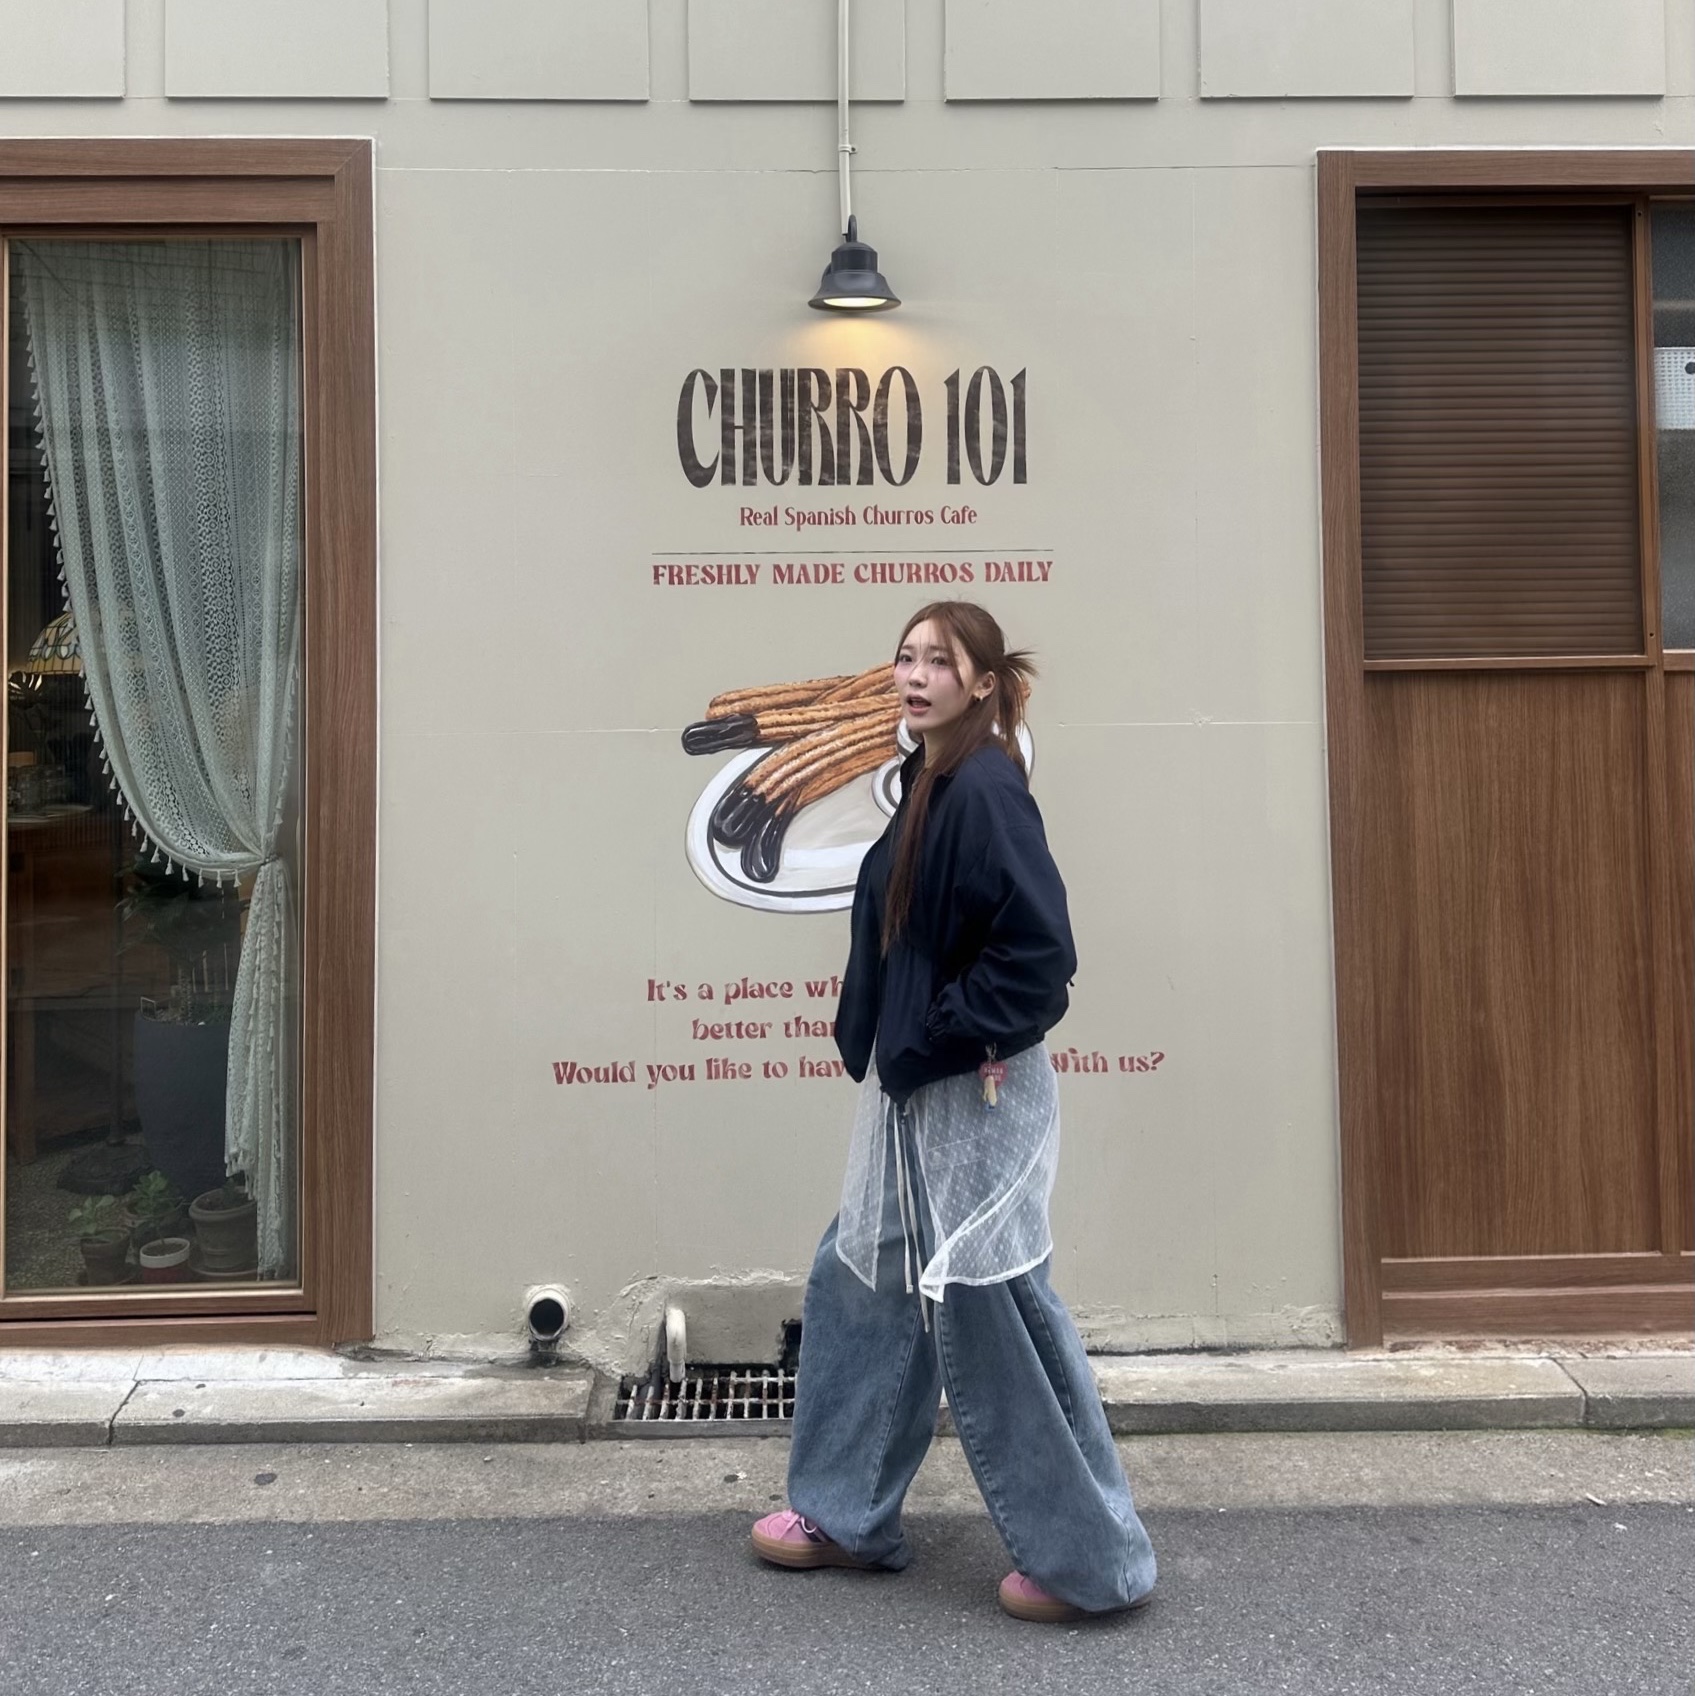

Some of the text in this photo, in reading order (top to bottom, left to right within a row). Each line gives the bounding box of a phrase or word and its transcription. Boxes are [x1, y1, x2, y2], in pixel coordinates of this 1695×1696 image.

[677, 366, 1028, 488] CHURRO 101
[739, 504, 977, 531] Real Spanish Churros Cafe
[652, 561, 1053, 586] FRESHLY MADE CHURROS DAILY
[647, 978, 688, 1001] It's
[698, 982, 714, 1000] a
[724, 977, 794, 1005] place
[692, 1018, 773, 1040] better
[552, 1060, 636, 1084] Would
[646, 1063, 695, 1090] you
[705, 1057, 752, 1080] like
[762, 1060, 789, 1078] to
[1118, 1051, 1165, 1073] us?
